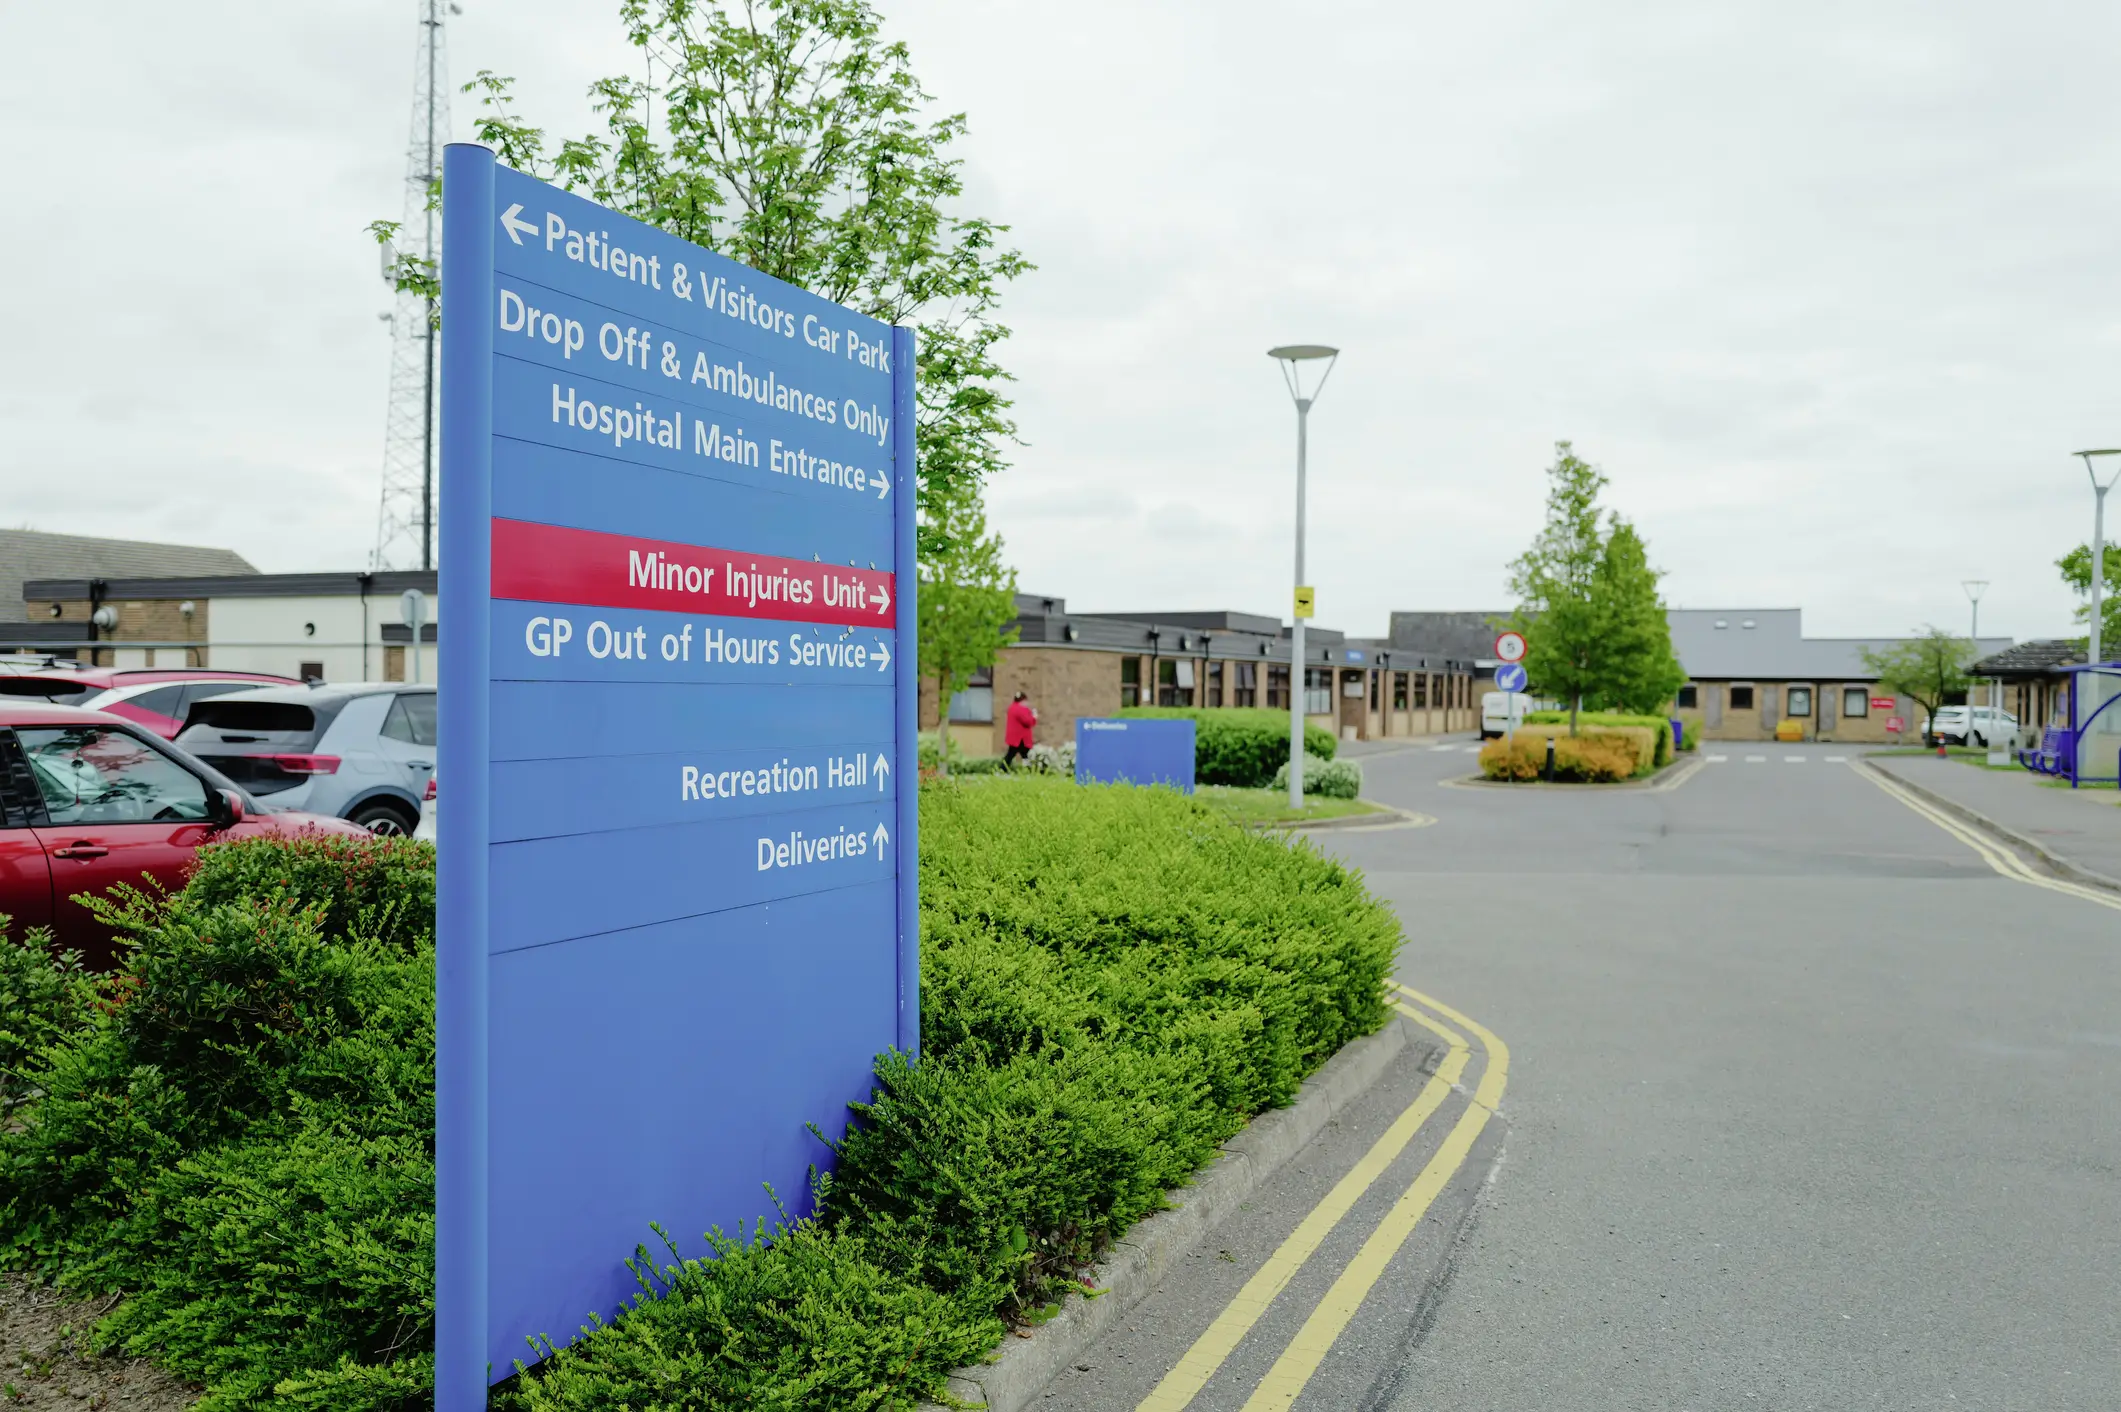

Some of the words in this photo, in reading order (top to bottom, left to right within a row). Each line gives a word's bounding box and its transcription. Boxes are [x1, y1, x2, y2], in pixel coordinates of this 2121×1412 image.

[546, 211, 661, 290] Patient
[672, 262, 693, 302] &
[700, 271, 795, 338] Visitors
[803, 314, 840, 354] Car
[847, 329, 890, 374] Park
[500, 289, 584, 360] Drop
[599, 322, 651, 370] Off
[660, 341, 682, 380] &
[691, 351, 837, 425] Ambulances
[843, 399, 889, 447] Only
[552, 383, 682, 450] Hospital
[695, 419, 759, 468] Main
[770, 439, 866, 491] Entrance
[629, 550, 715, 596] Minor
[726, 562, 813, 608] Injuries
[823, 574, 866, 609] Unit
[525, 616, 573, 657] GP
[586, 620, 647, 660] Out
[660, 624, 692, 661] of
[705, 628, 779, 665] Hours
[789, 633, 866, 668] Service
[682, 758, 818, 801] Recreation
[828, 753, 867, 787] Hall
[757, 826, 867, 871] Deliveries
